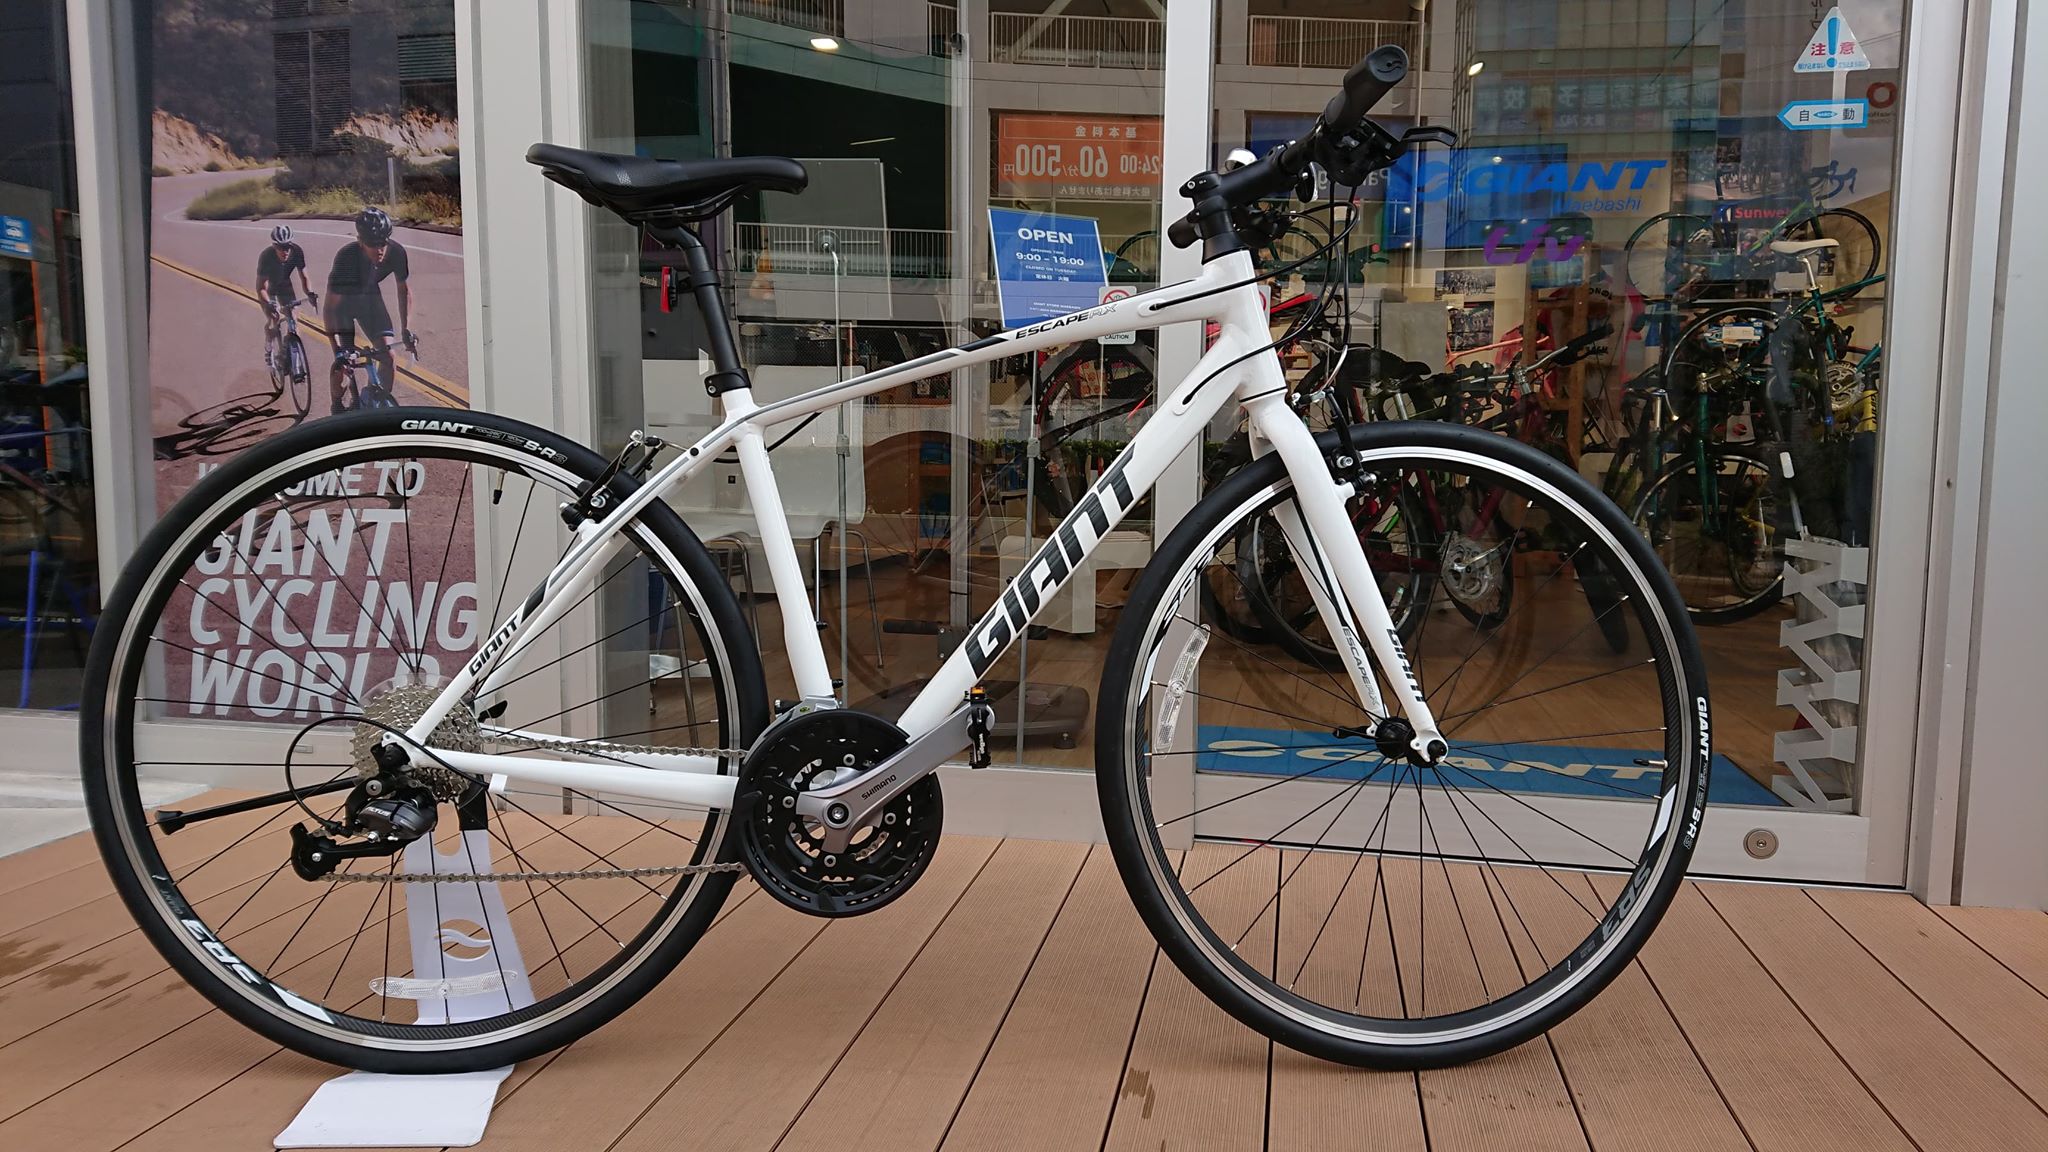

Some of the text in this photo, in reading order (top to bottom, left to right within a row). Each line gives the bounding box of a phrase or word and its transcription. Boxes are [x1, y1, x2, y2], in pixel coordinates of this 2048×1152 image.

[1811, 41, 1856, 56] 注意
[1799, 107, 1855, 122] 自動
[1462, 160, 1667, 195] GIANT
[1018, 228, 1074, 245] OPEN
[1484, 223, 1585, 265] Liv
[1016, 252, 1042, 262] 9:00
[1053, 255, 1085, 266] 19:00
[401, 419, 473, 434] GIANT
[374, 461, 426, 496] TO
[194, 508, 410, 577] GIANT
[965, 442, 1136, 680] GIANT
[190, 578, 479, 652] CYCLING
[468, 614, 518, 677] GIANT
[1696, 696, 1709, 761] GIANT
[1297, 748, 1662, 781] GANT
[861, 774, 897, 800] SHIMANO
